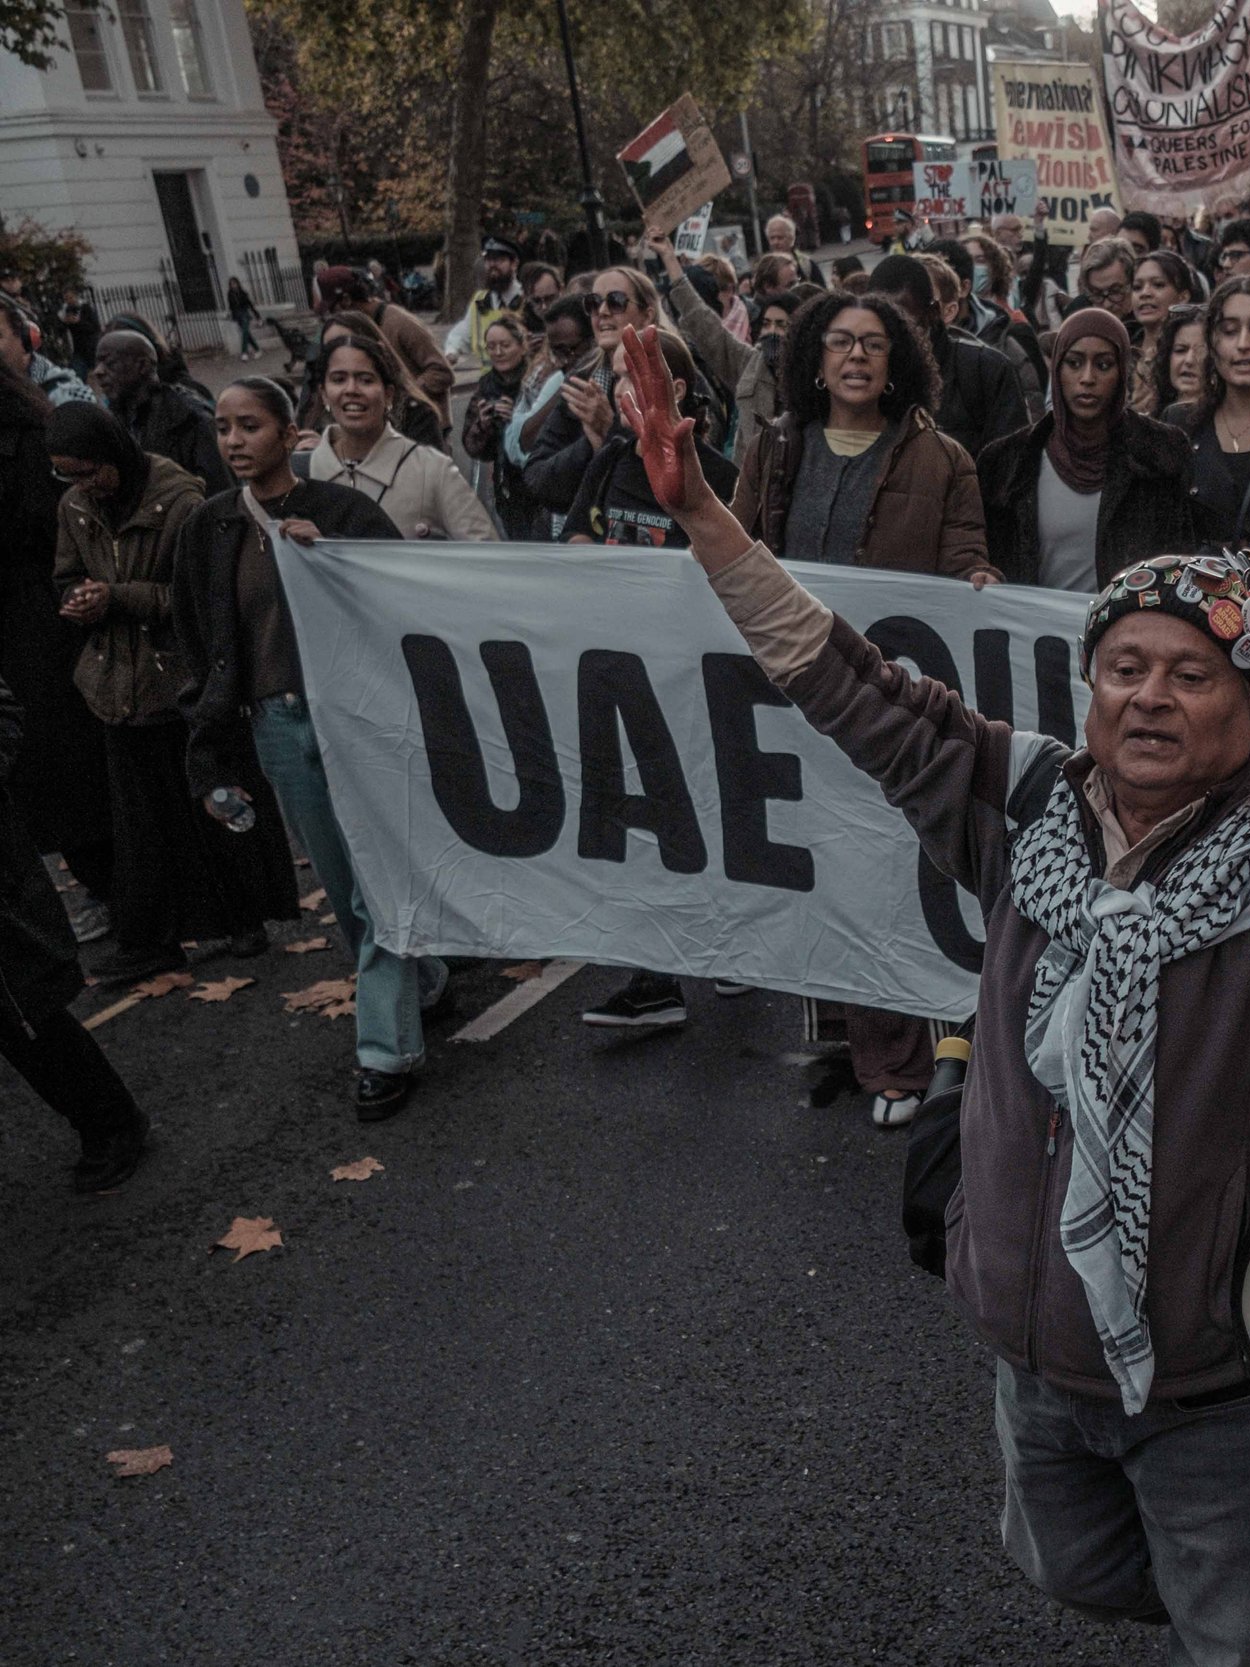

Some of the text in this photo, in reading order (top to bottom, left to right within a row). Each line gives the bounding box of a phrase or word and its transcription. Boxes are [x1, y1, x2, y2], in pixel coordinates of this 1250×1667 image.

[1151, 133, 1217, 153] QUEERS
[1154, 141, 1249, 174] PALESTINE
[978, 161, 1010, 181] PAL
[929, 180, 951, 198] THE
[982, 181, 1011, 197] ACT
[981, 197, 1016, 218] NOW
[608, 508, 673, 530] STOP THE GENOCIDE
[1215, 607, 1239, 633] ARMING
[1224, 605, 1241, 622] STOP
[1211, 613, 1232, 638] ISRAEL
[401, 633, 816, 893] UAE
